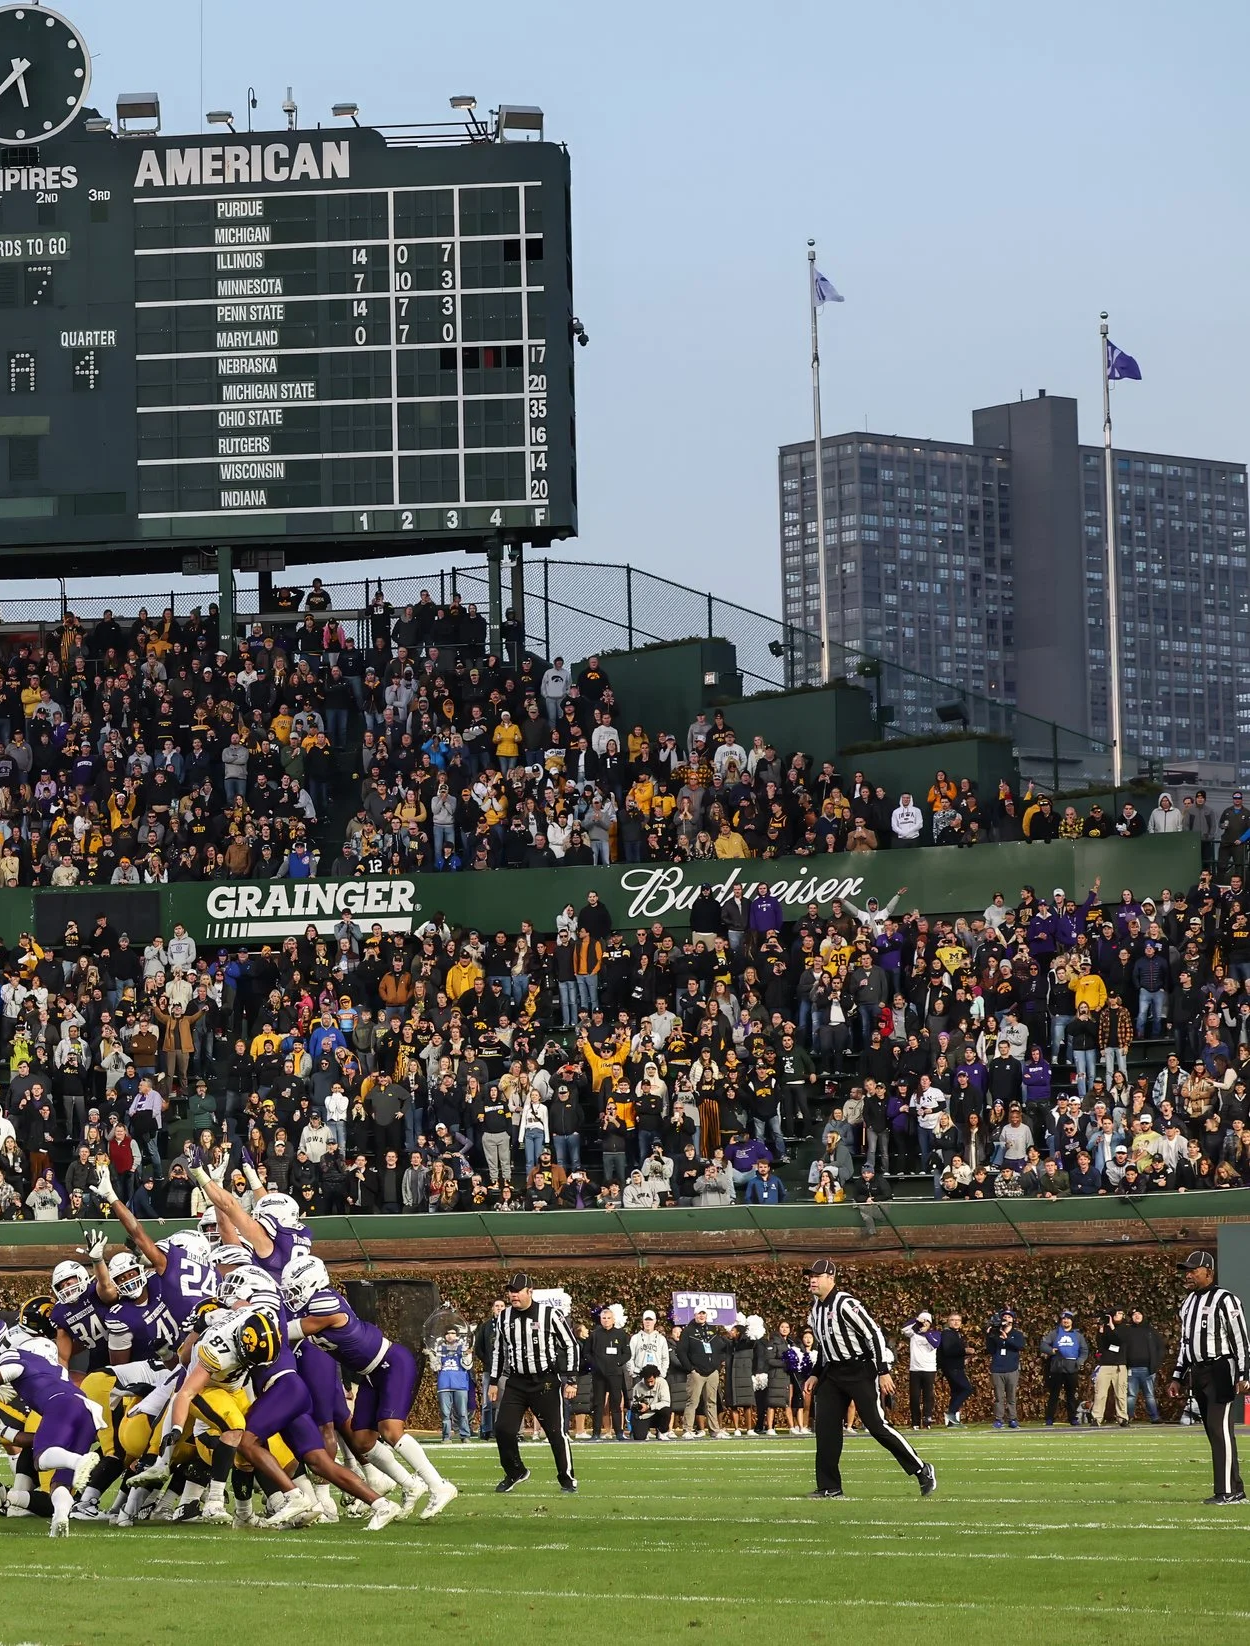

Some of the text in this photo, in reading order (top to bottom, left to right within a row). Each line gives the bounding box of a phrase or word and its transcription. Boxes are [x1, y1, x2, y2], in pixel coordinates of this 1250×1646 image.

[134, 140, 350, 188] AMERICAN
[36, 191, 58, 204] 2ND
[88, 188, 111, 202] 3RD
[217, 200, 263, 218] PURDUE
[26, 238, 44, 256] TO
[49, 237, 67, 255] GO
[214, 226, 270, 244] MICHIGAN
[217, 244, 452, 270] ILLINOIS 14 0 7
[27, 266, 52, 305] 7
[217, 270, 453, 296] MINNESOTA 7 10 3
[217, 297, 454, 322] PENN STATE 14 7 3
[60, 330, 116, 347] QUARTER
[216, 323, 454, 348] MARYLAND 0 7 0
[75, 350, 99, 389] 4
[218, 347, 546, 374] NEBRASKA 17
[222, 374, 547, 401] MICHIGAN STATE 20
[218, 399, 547, 427] OHIO STATE 35
[218, 427, 547, 454] RUTGERS 16
[220, 453, 548, 480] WISCONSIN 14
[221, 479, 548, 507] INDIANA 20
[359, 508, 545, 531] 1 2 3 4 F
[368, 859, 383, 874] 12
[206, 880, 416, 919] GRAINGER
[180, 1257, 217, 1297] 24
[676, 1293, 734, 1309] STAND
[70, 1313, 109, 1350] 34
[209, 1335, 231, 1354] 87
